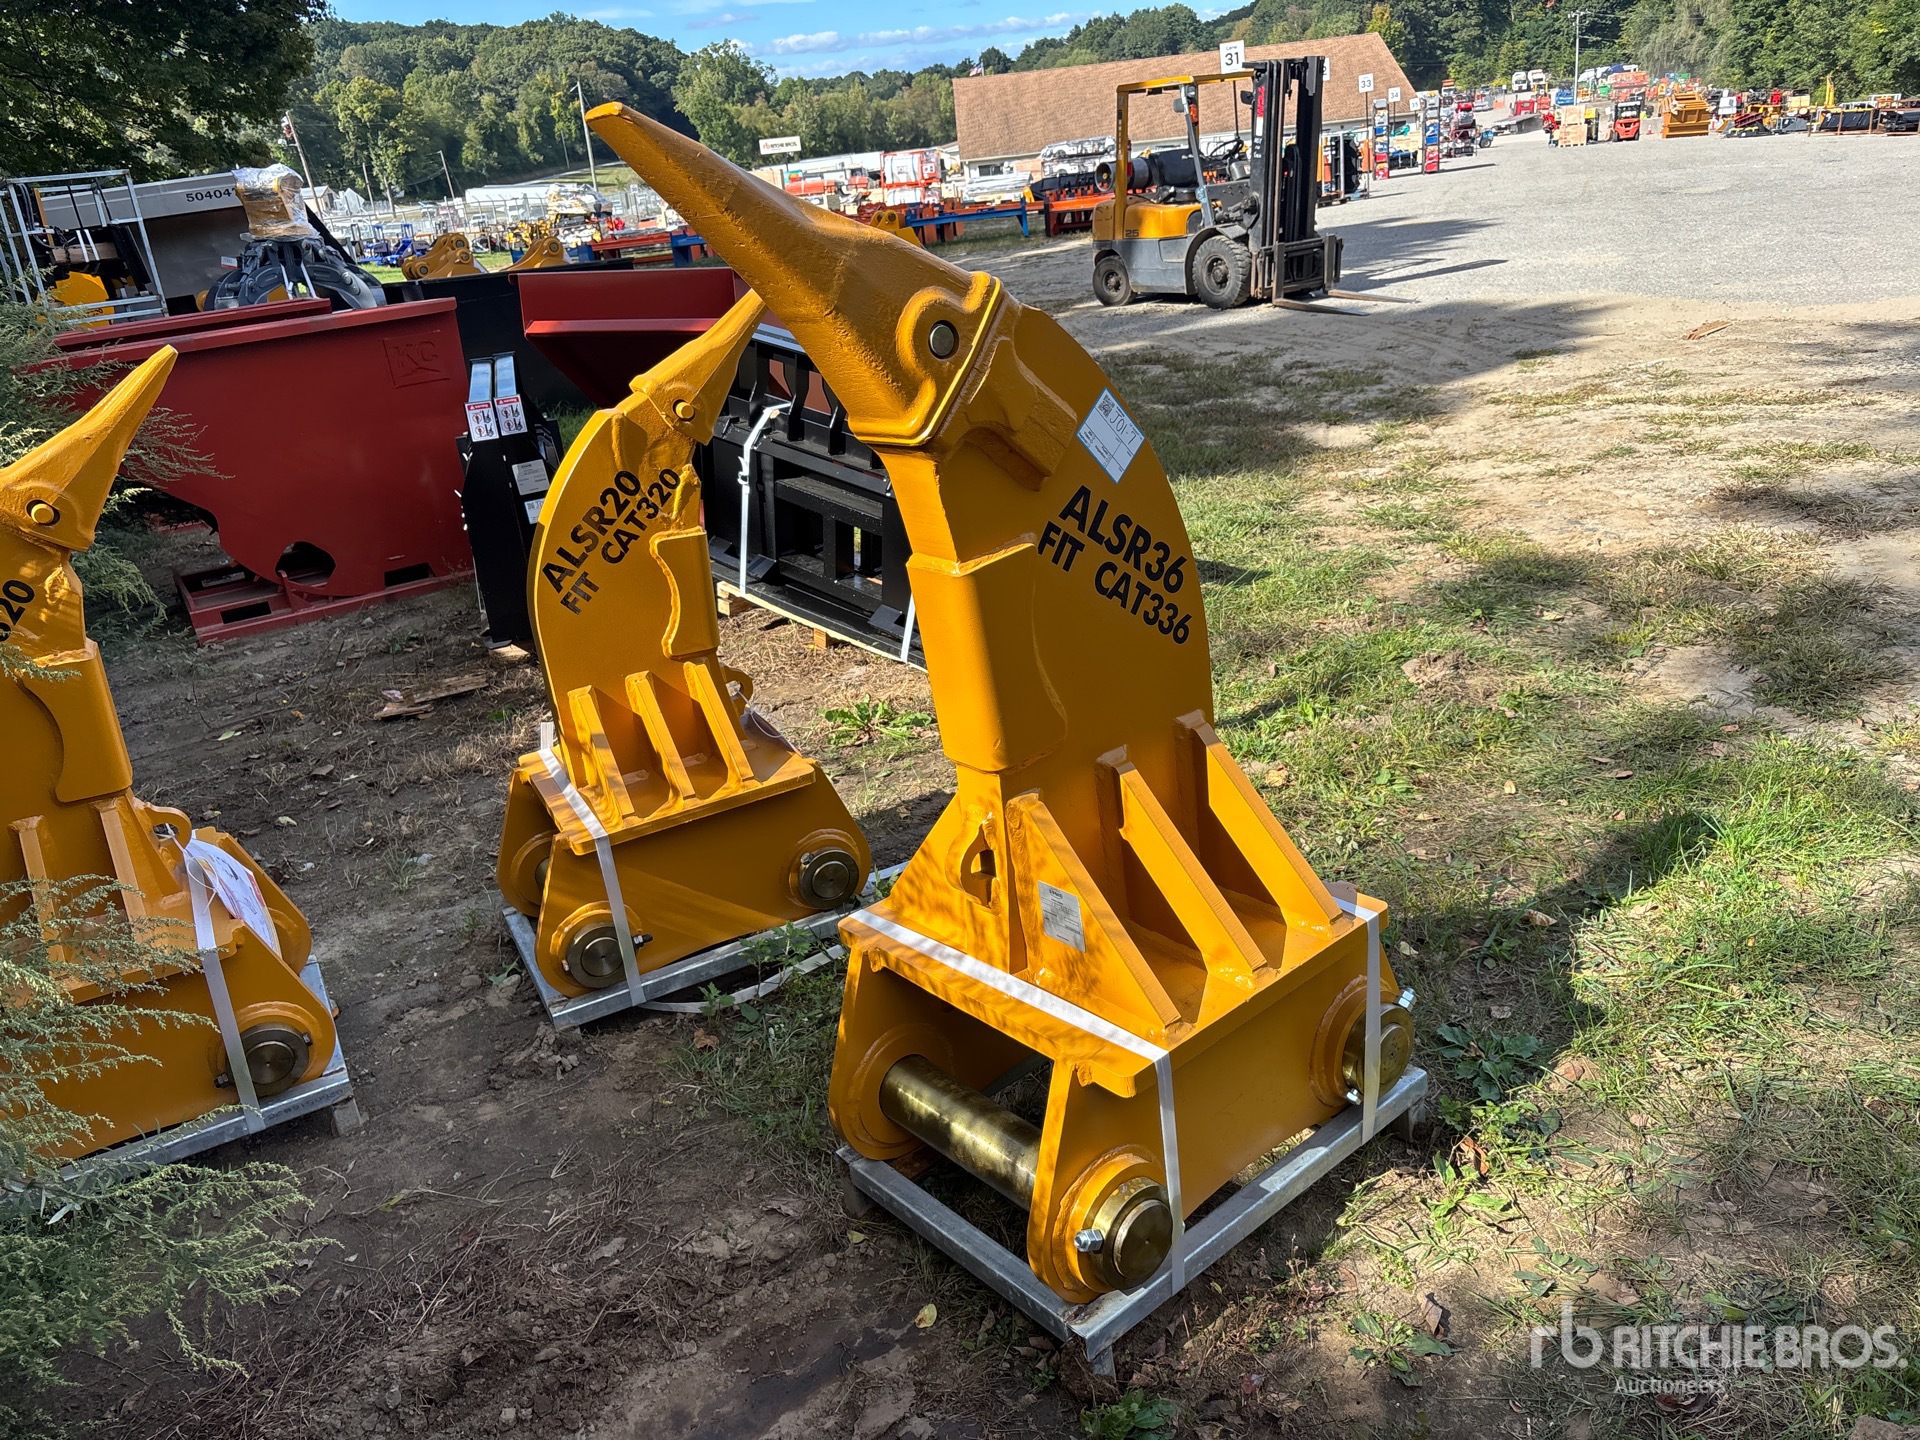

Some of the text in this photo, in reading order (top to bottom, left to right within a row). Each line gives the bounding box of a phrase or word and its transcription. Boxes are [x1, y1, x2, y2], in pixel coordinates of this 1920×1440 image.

[1225, 52, 1239, 66] 31
[1361, 79, 1372, 89] 33
[1125, 229, 1139, 237] 25
[542, 470, 641, 593] ALSR20
[560, 468, 681, 615] FIT CAT320
[1038, 521, 1192, 644] FIT CAT336
[1058, 485, 1187, 593] ALSR36
